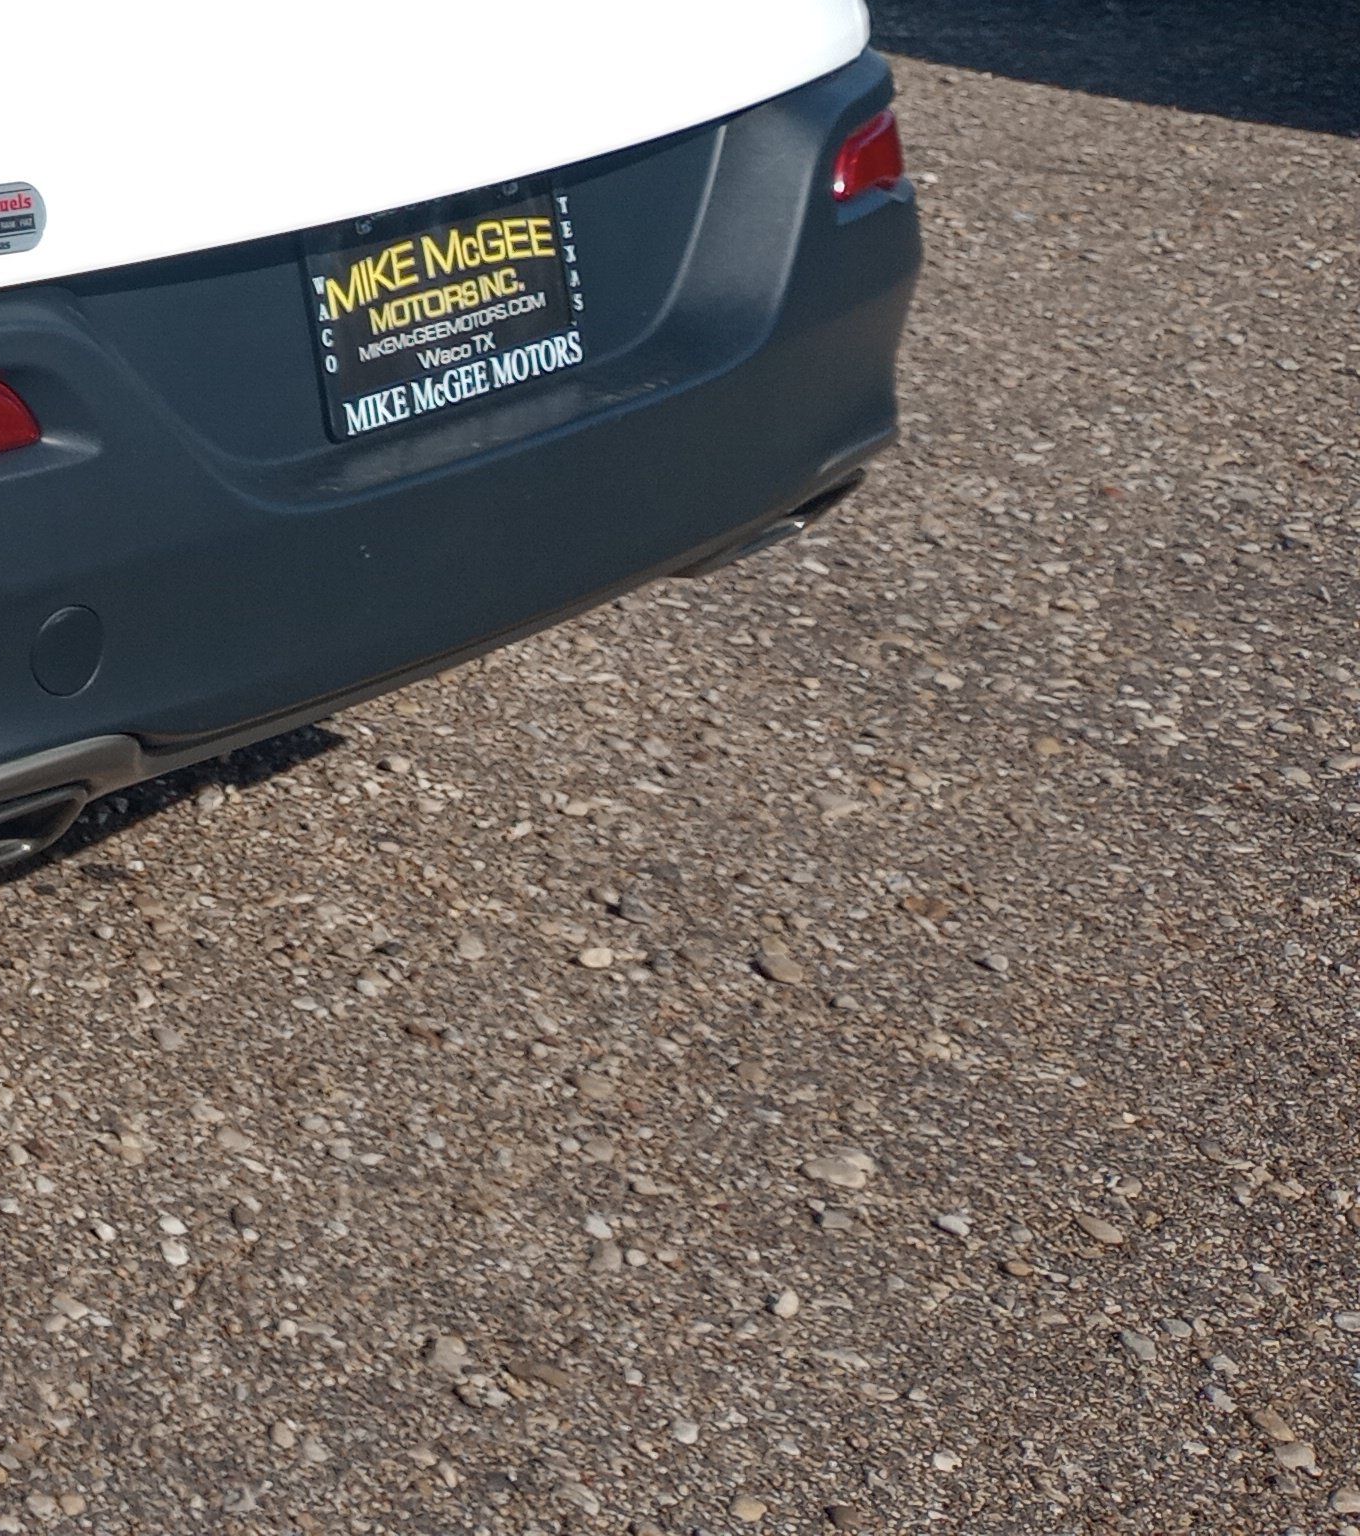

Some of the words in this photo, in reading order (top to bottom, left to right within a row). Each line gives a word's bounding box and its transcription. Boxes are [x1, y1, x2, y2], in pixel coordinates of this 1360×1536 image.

[325, 240, 420, 322] MIKE
[420, 217, 556, 280] McGEE
[369, 278, 479, 336] MOTORS
[477, 267, 526, 303] INC.
[555, 196, 585, 312] TEXAS
[312, 276, 339, 374] WACO
[417, 343, 472, 370] Waco
[471, 331, 497, 355] TX
[343, 385, 411, 436] MIKE
[411, 360, 490, 415] McGEE
[490, 331, 584, 388] MOTORS
